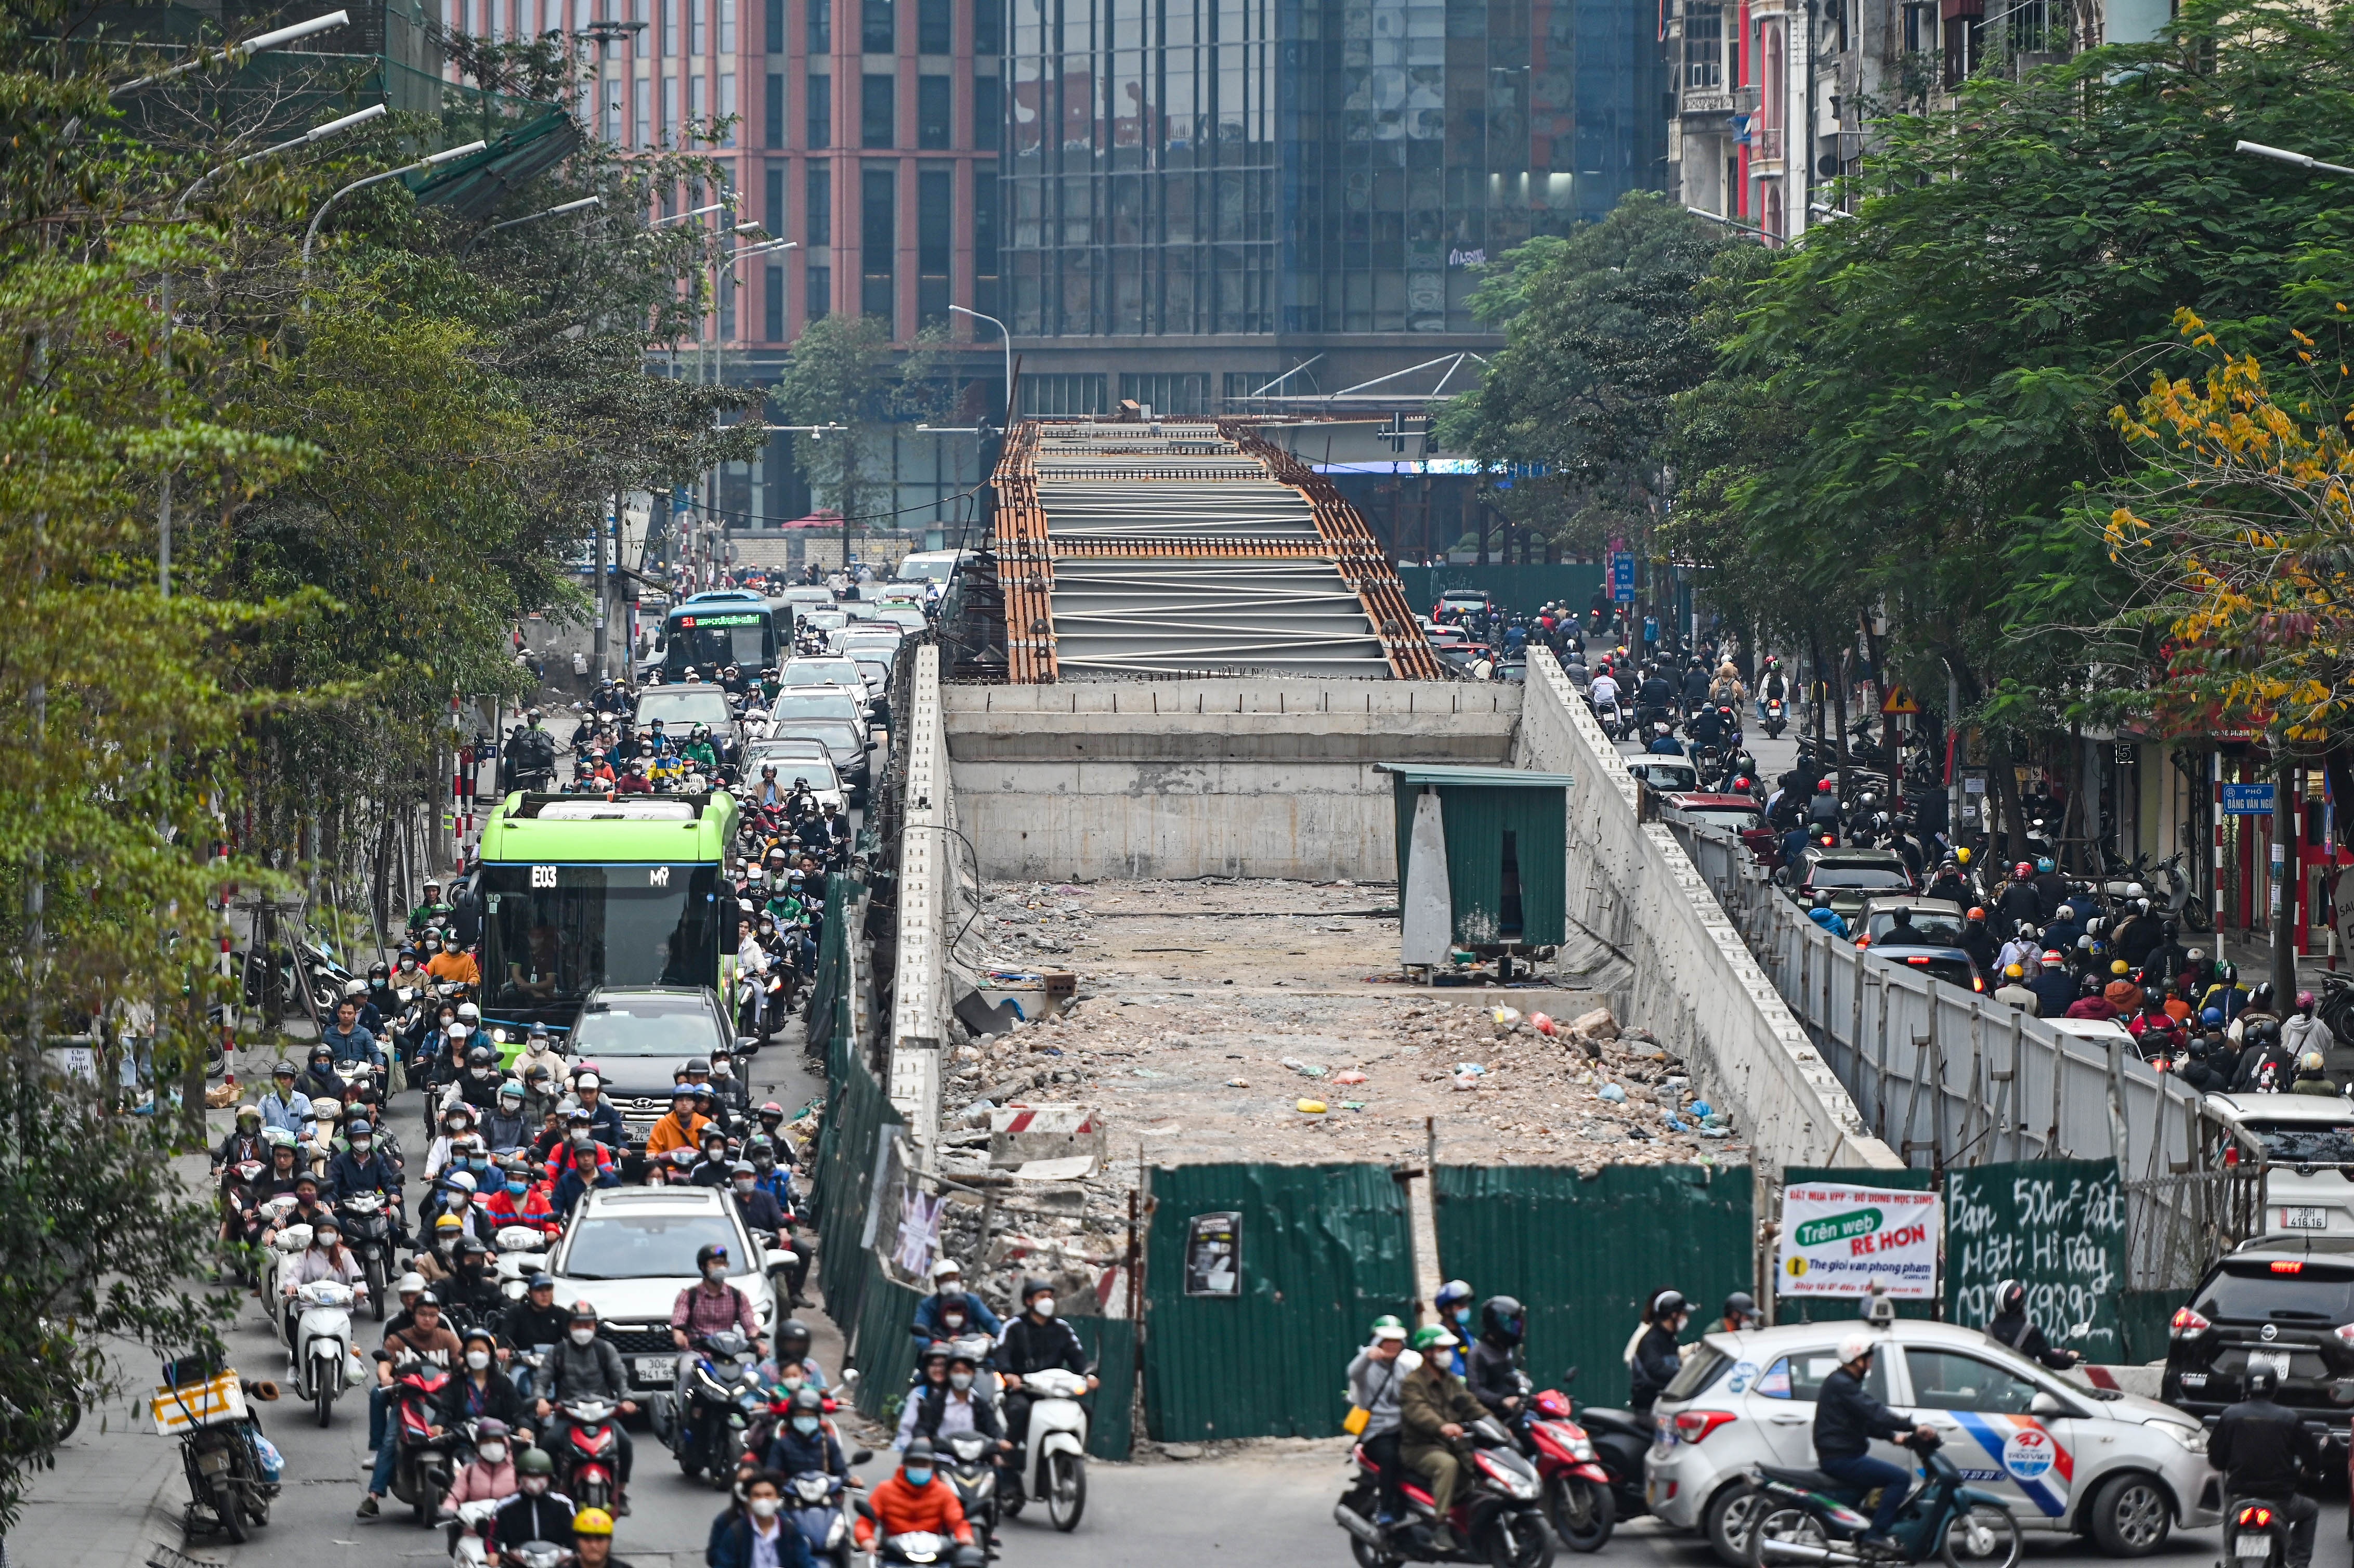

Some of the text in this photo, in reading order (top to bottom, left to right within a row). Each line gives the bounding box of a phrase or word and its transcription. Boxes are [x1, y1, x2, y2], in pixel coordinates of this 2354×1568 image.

[2227, 796, 2244, 811] ĐẶNG
[2246, 797, 2258, 809] VĂN
[532, 866, 557, 888] E03
[1830, 1192, 1846, 1201] VPP
[1914, 1195, 1934, 1205] SINH
[1951, 1172, 1997, 1235] Bán
[2298, 1208, 2315, 1217] 30H
[1802, 1214, 1875, 1243] Trên web
[1879, 1223, 1927, 1250] HƠN
